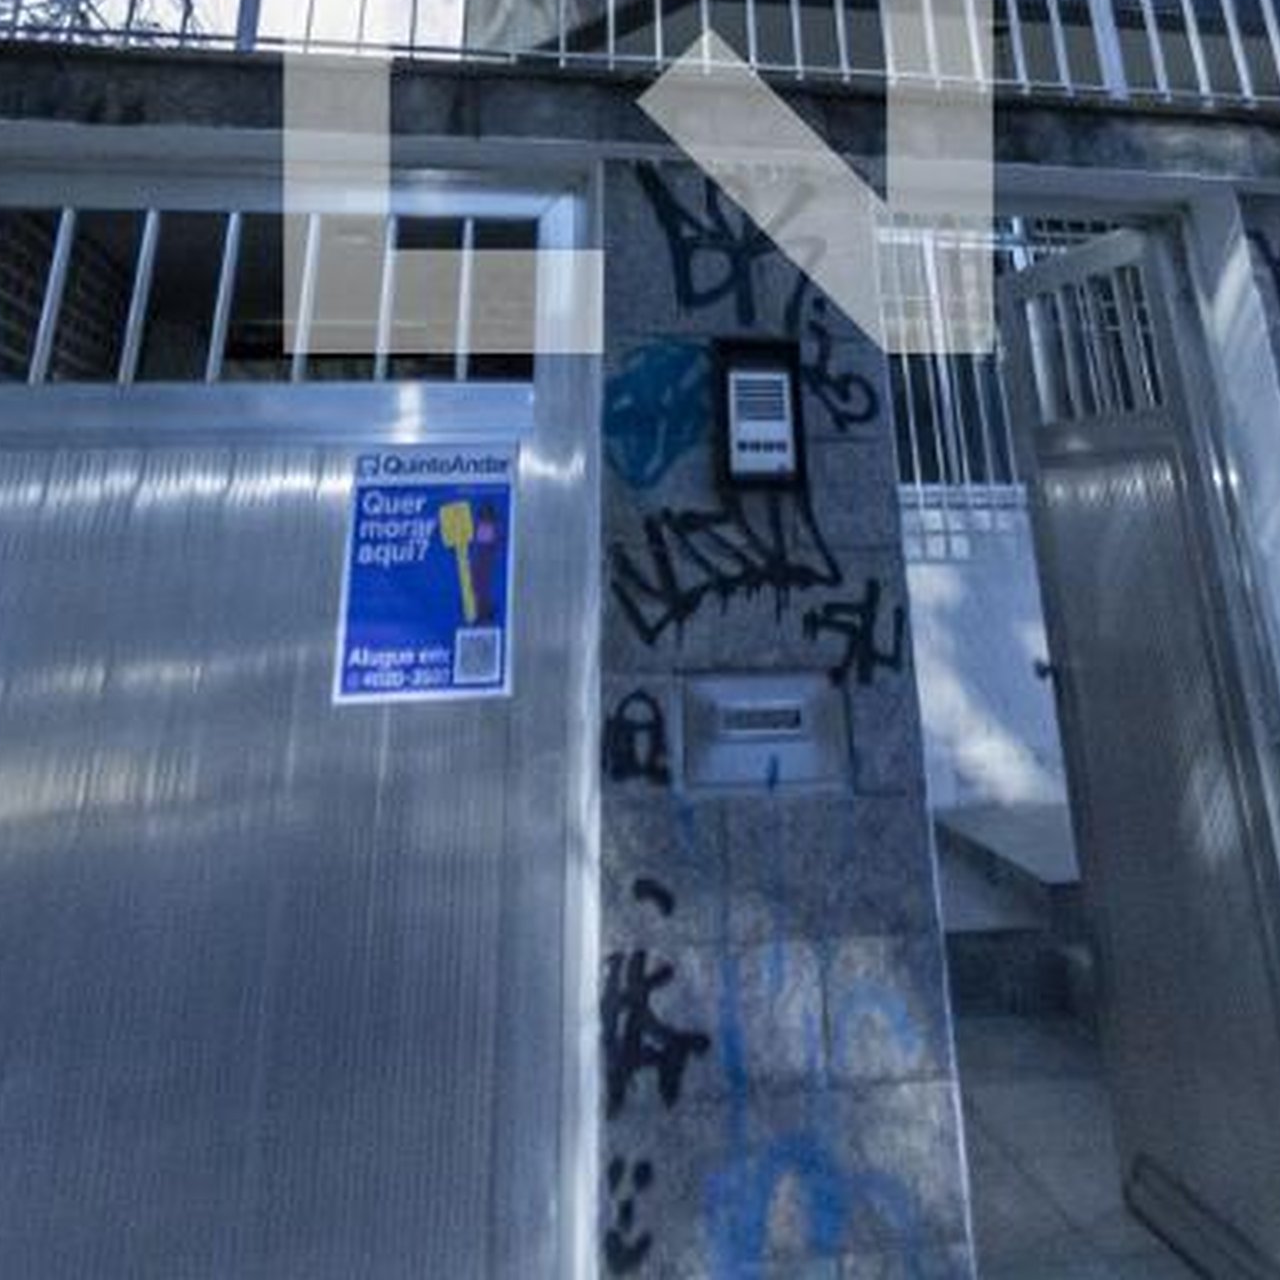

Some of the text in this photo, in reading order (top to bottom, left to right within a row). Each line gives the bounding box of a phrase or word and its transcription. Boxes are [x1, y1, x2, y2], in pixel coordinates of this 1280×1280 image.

[363, 490, 426, 515] Quer
[359, 516, 437, 540] morar
[358, 537, 429, 568] aqui?
